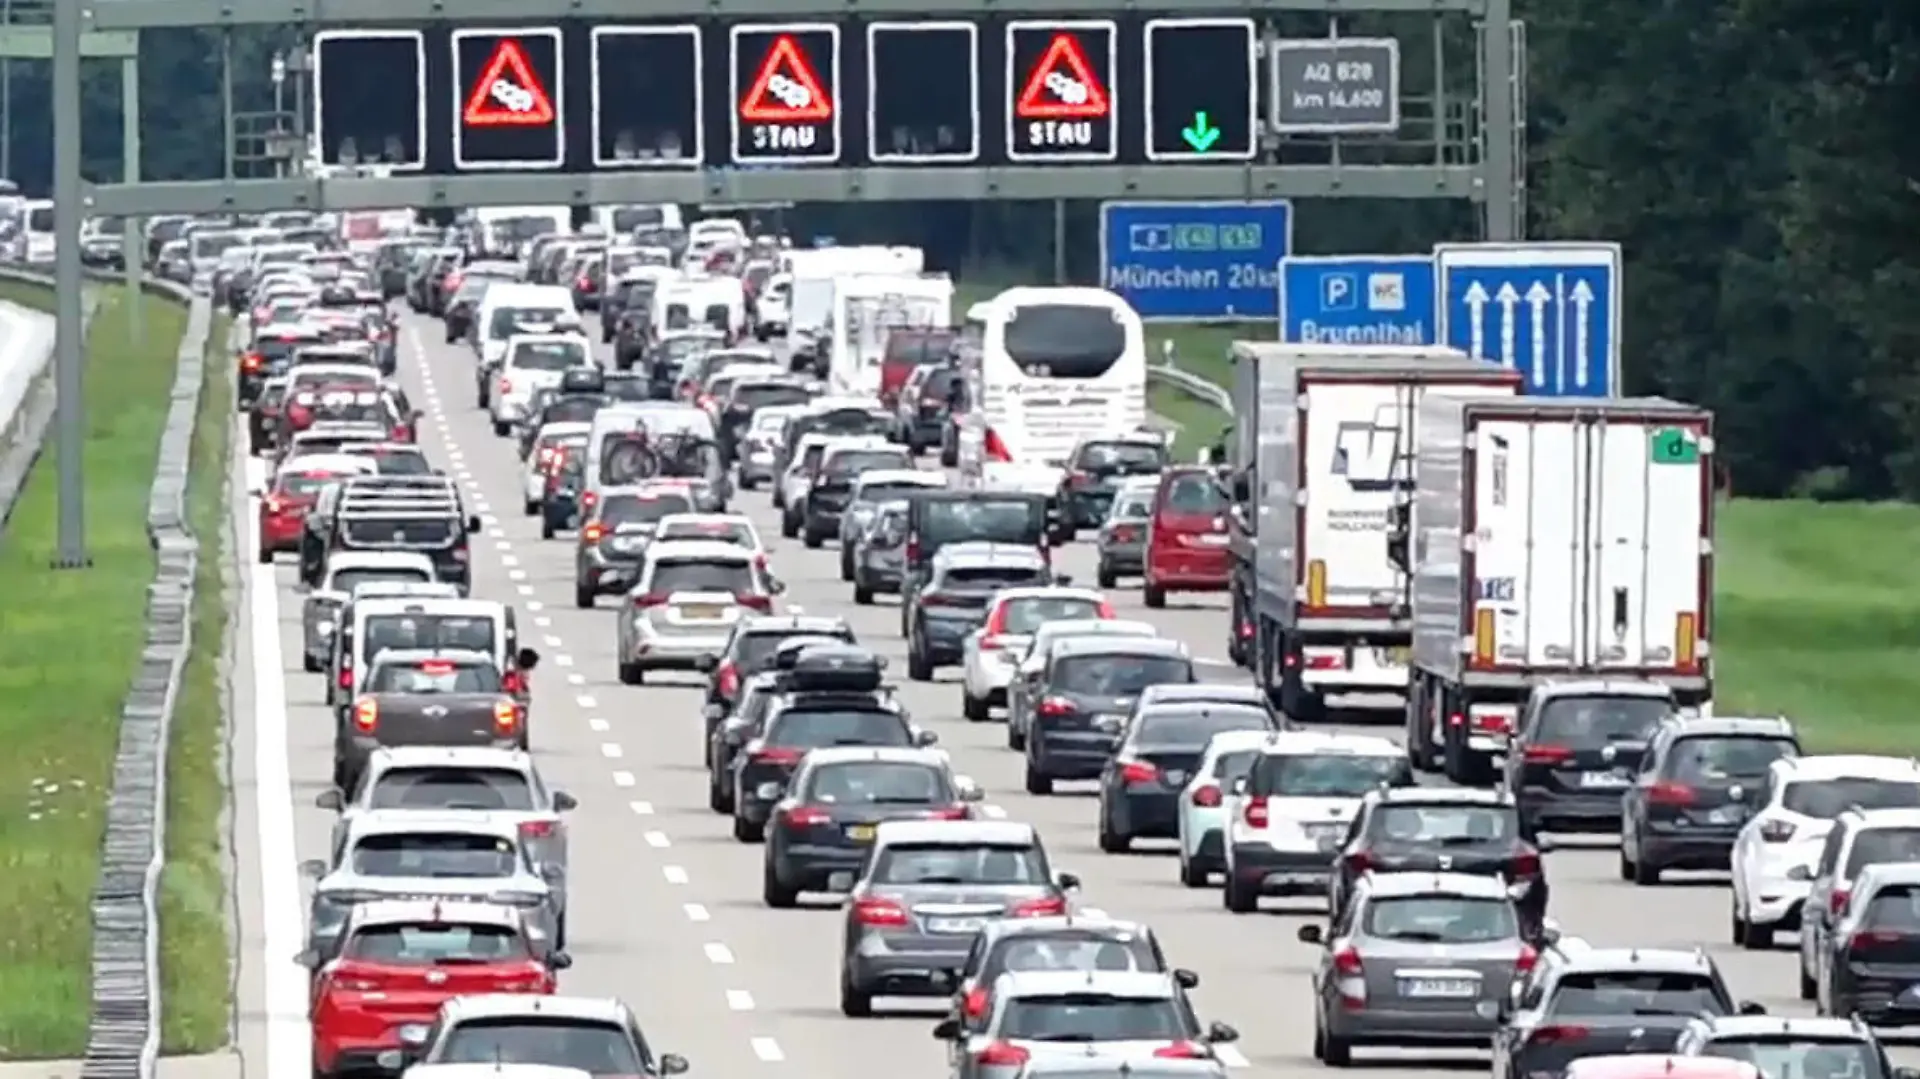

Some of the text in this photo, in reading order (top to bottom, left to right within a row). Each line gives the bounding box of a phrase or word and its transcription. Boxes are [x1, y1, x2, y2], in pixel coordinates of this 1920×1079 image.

[1293, 89, 1324, 108] km
[753, 124, 815, 149] STAU
[1029, 120, 1091, 146] STAU
[1110, 263, 1219, 290] München
[1328, 277, 1399, 306] P WC
[1301, 318, 1423, 344] Brunnthal
